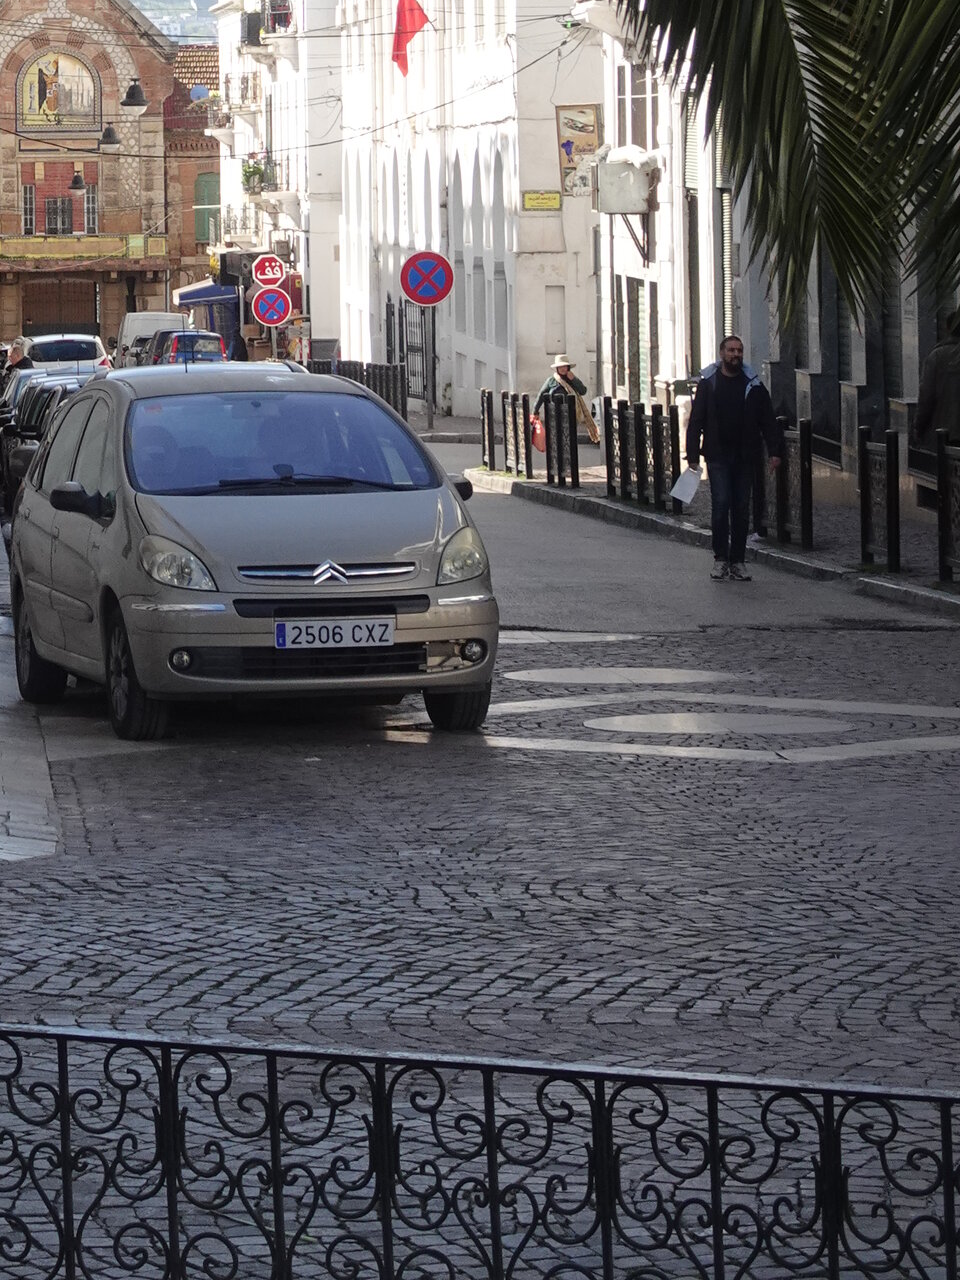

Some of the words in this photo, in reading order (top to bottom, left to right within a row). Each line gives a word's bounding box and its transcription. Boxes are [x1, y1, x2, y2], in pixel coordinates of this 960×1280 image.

[257, 261, 282, 279] قف
[291, 625, 343, 644] 2506
[351, 624, 390, 643] CXZ
